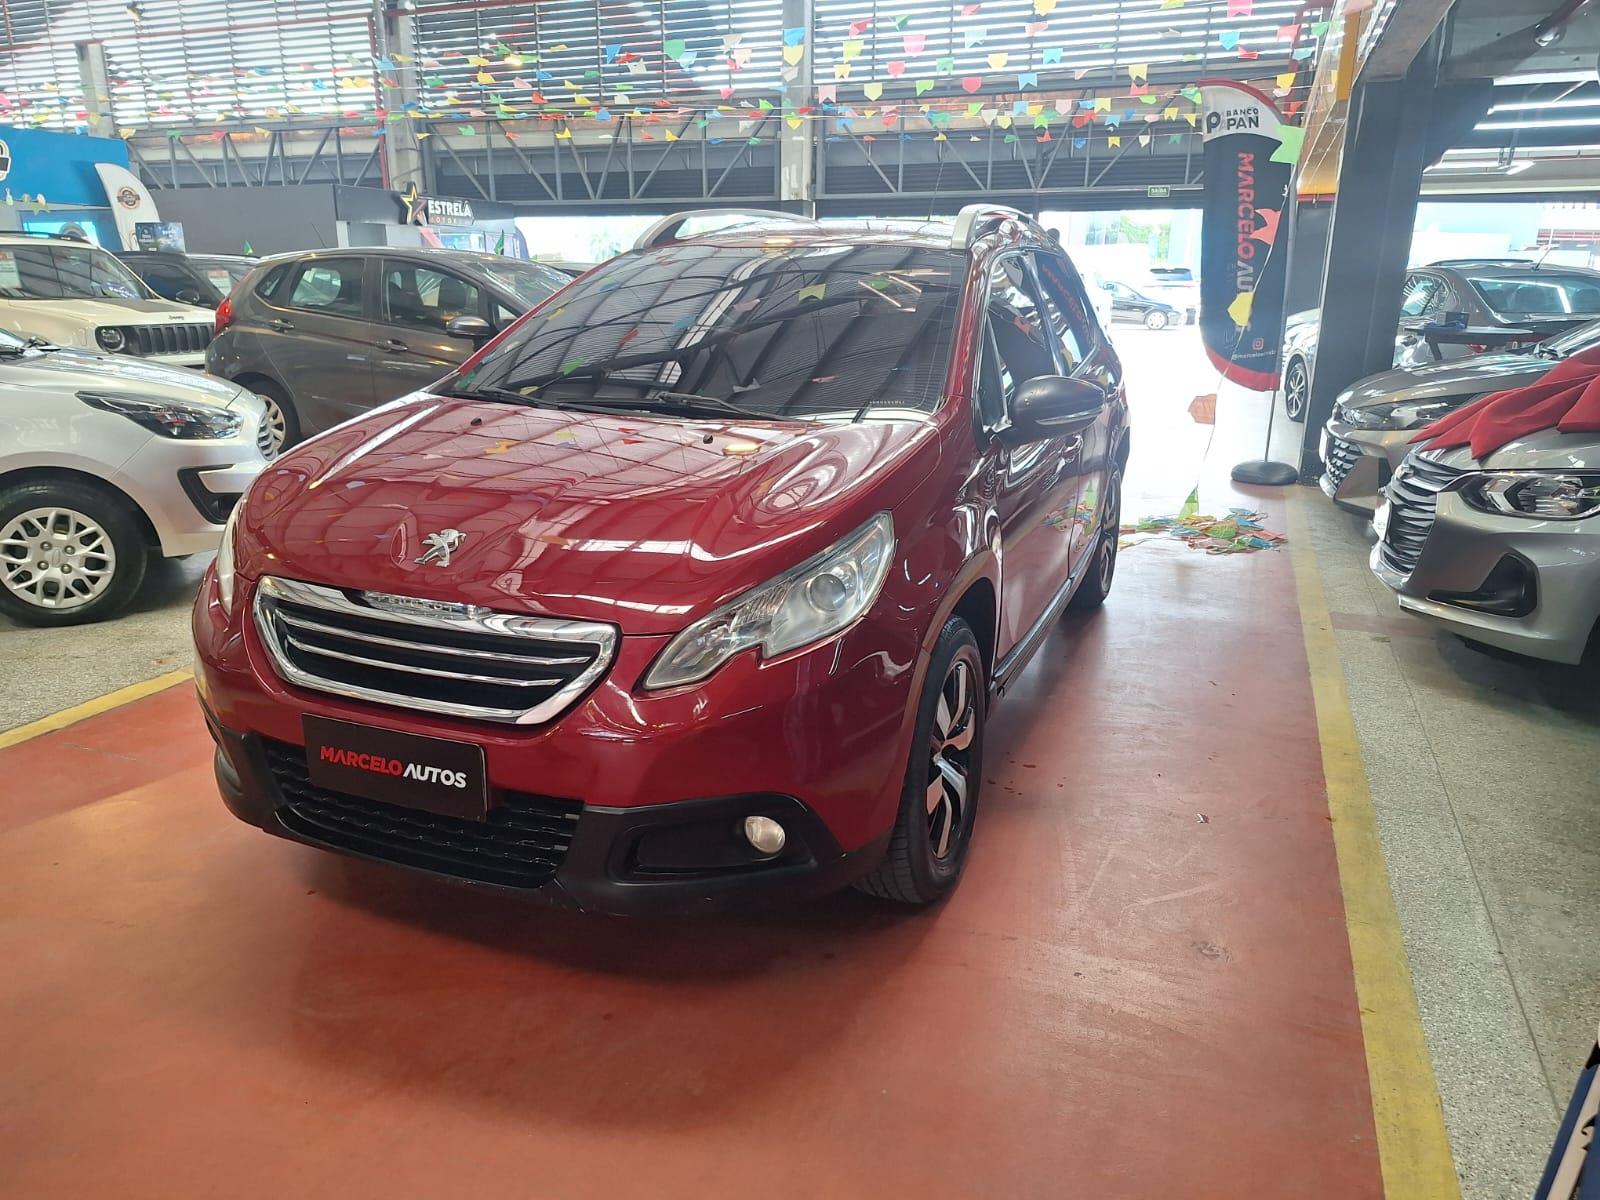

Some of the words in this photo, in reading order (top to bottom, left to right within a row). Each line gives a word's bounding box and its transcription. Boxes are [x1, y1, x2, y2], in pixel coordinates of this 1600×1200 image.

[1226, 107, 1259, 117] BANCO
[1226, 116, 1259, 131] PAN
[428, 200, 472, 217] ESTRELA
